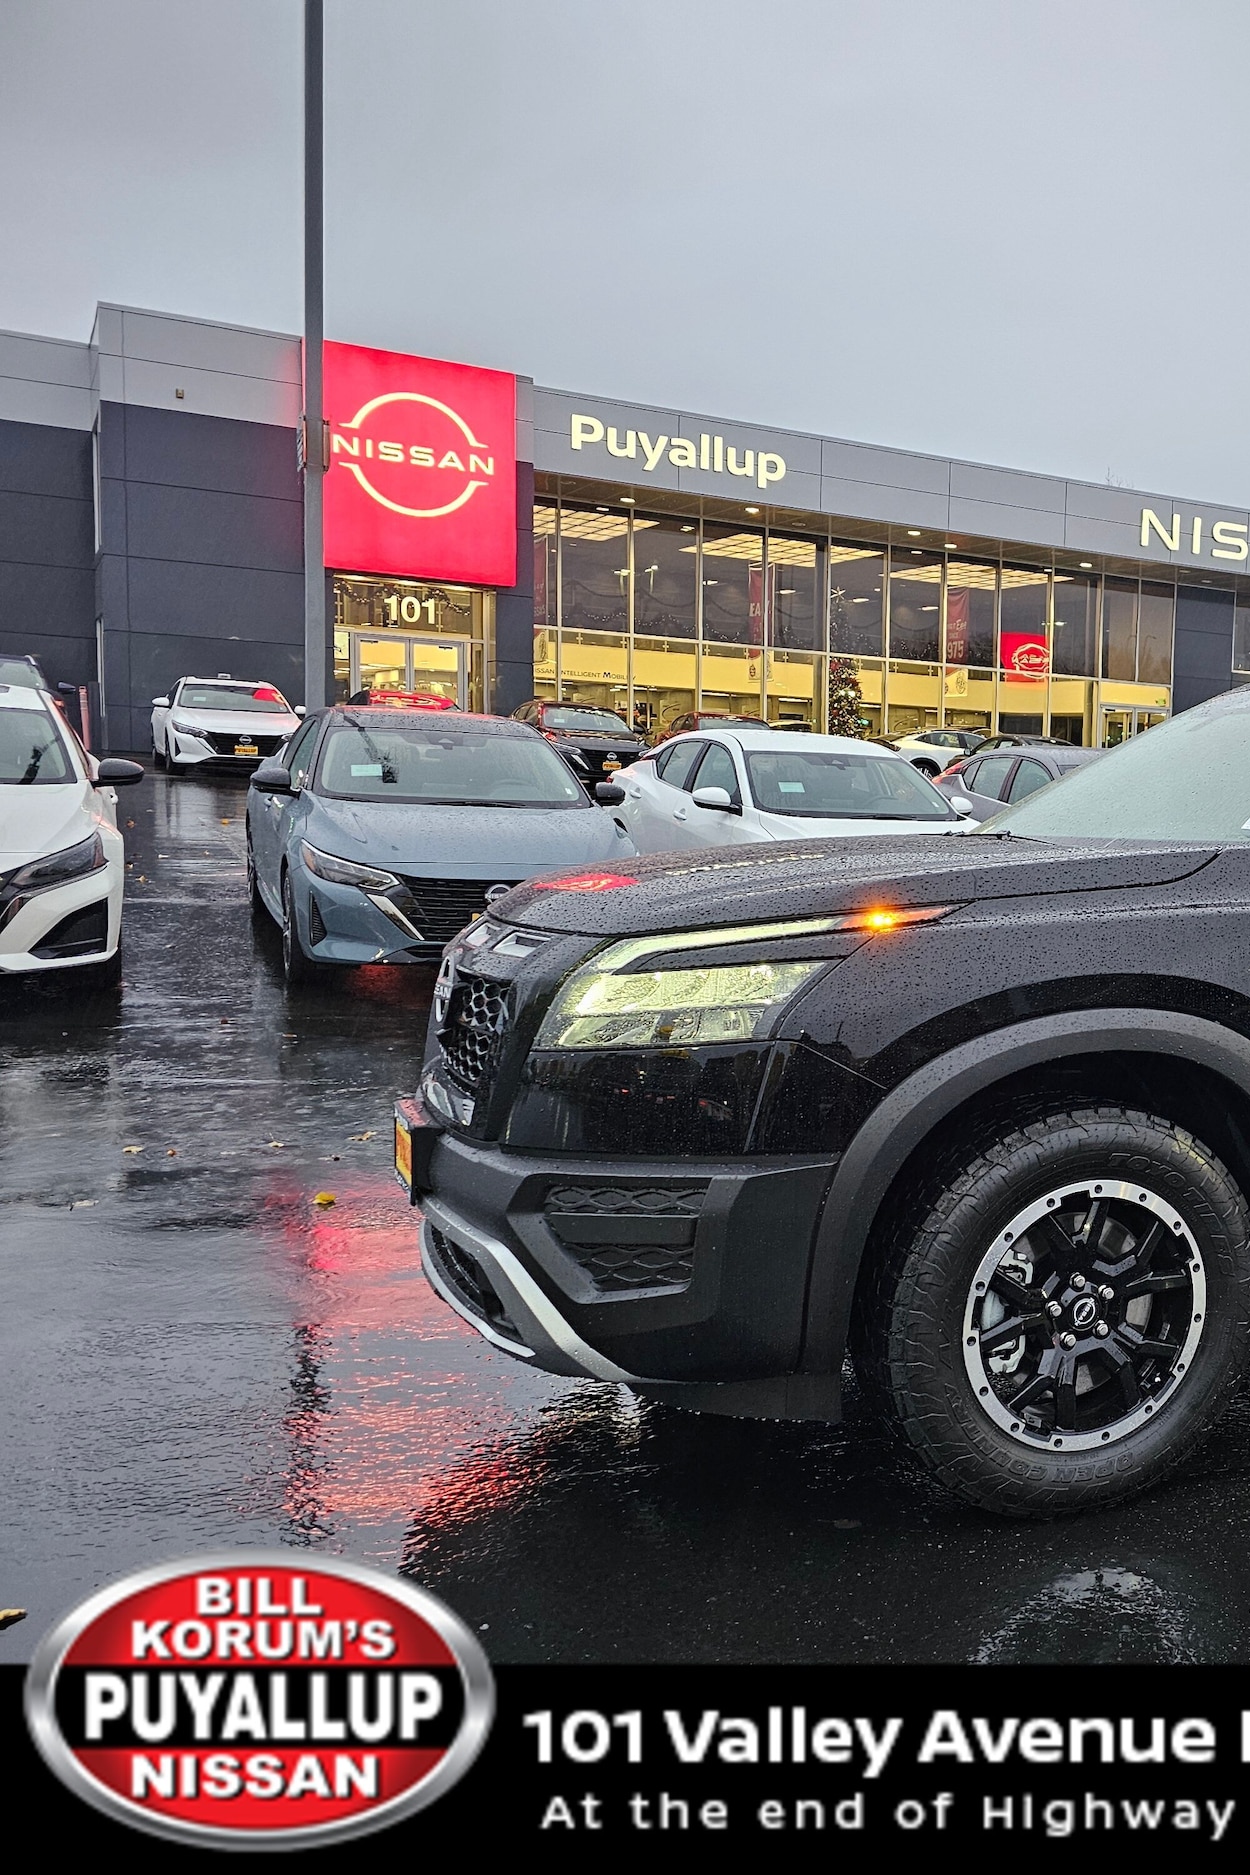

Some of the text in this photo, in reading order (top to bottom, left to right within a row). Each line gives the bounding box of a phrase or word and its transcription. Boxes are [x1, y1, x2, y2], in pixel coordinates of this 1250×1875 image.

[332, 433, 495, 476] NISSAN
[570, 413, 787, 489] Puyallup
[383, 594, 436, 625] 101
[947, 641, 964, 659] 975
[535, 667, 636, 681] ISSAN NTELLIGENT MOBILY
[1107, 1152, 1187, 1189] TOYO
[1182, 1185, 1236, 1278] TIRES
[944, 1382, 1049, 1481] COUNTRY
[1052, 1451, 1135, 1483] OPEN
